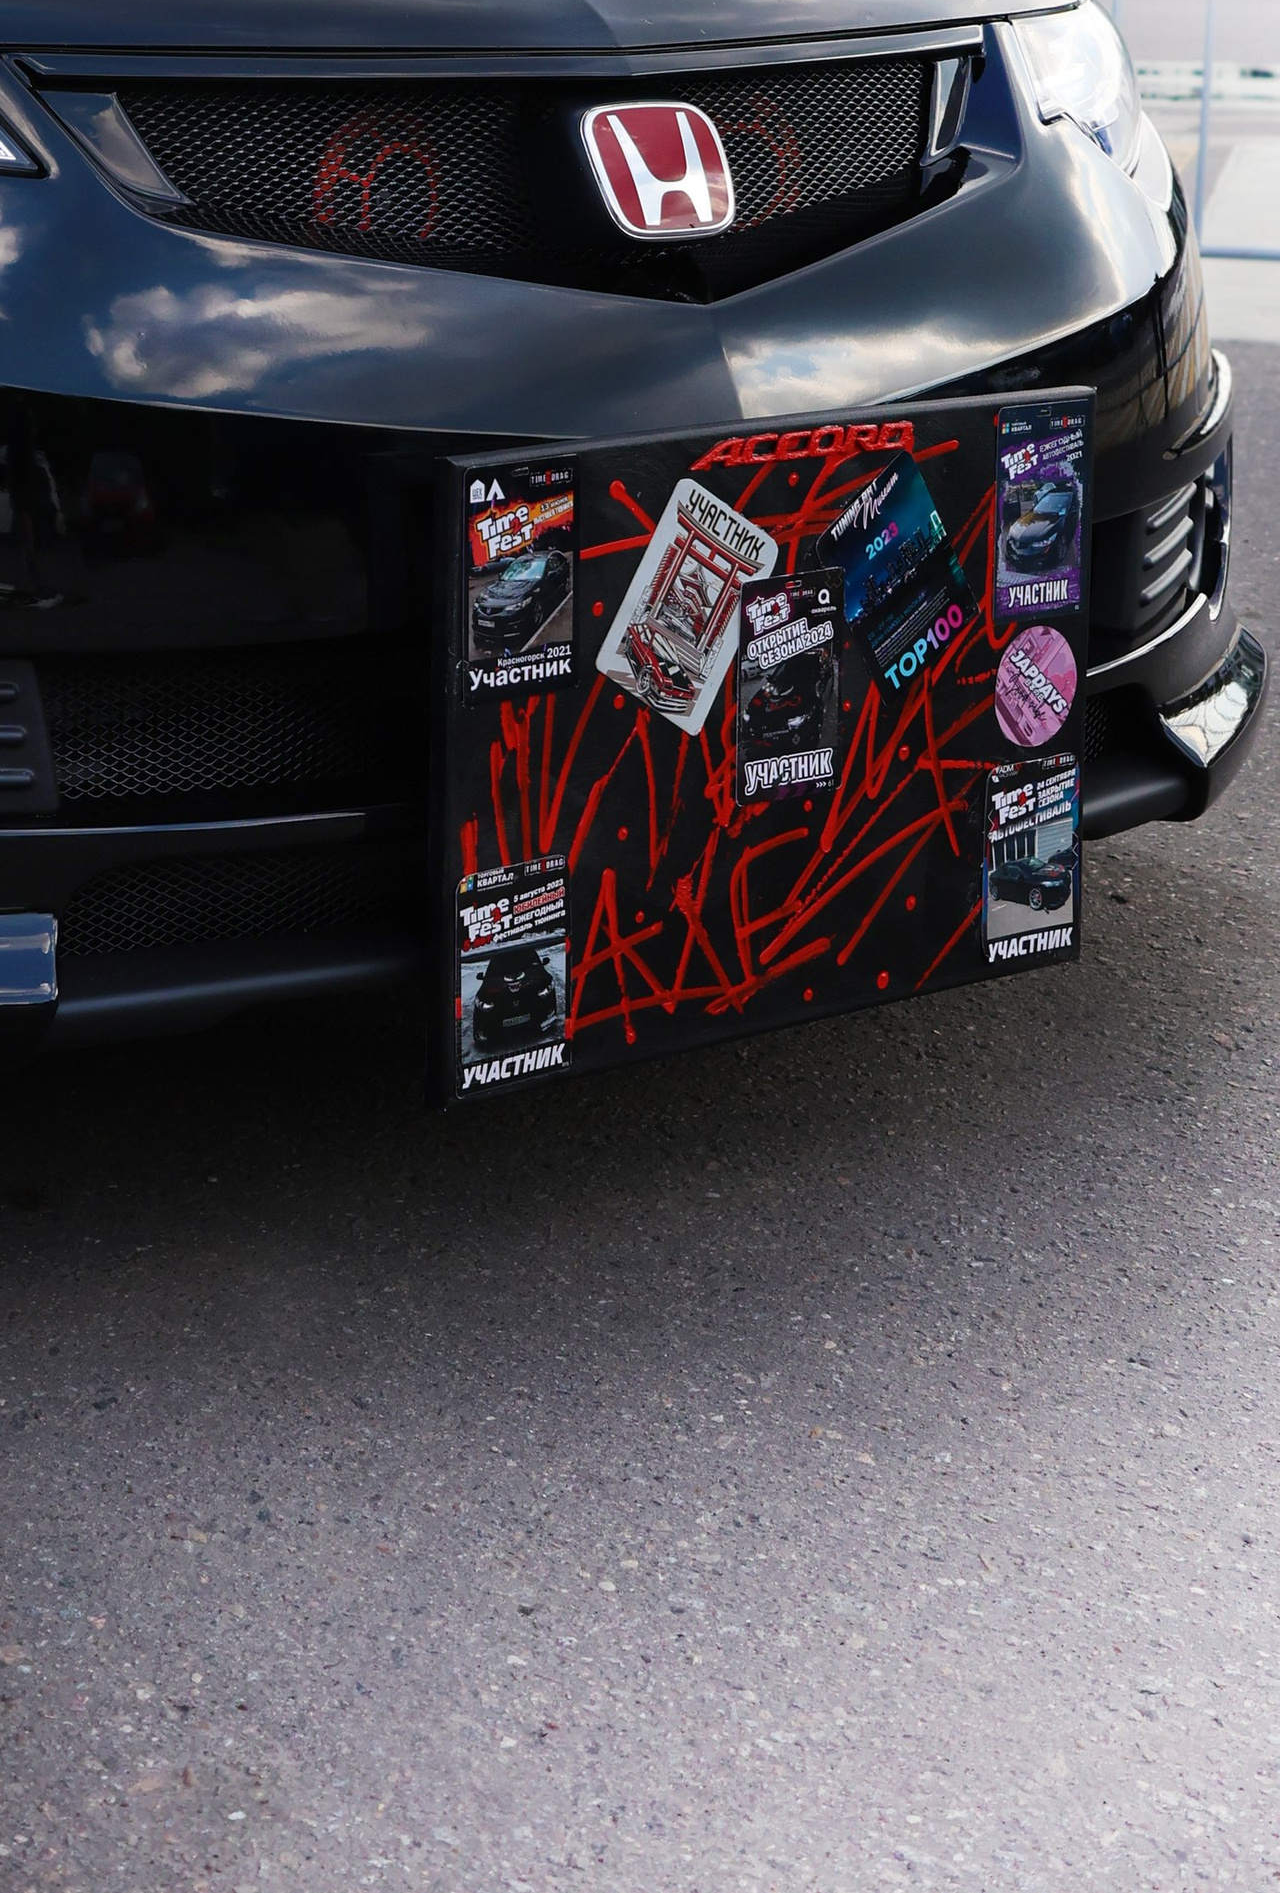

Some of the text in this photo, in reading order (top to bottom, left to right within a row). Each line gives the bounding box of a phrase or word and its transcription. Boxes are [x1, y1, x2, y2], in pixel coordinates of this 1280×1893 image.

[688, 421, 914, 471] ACCORD
[1039, 428, 1083, 453] ЕЖЕГОДНЫЙ
[1065, 450, 1083, 462] 2021
[685, 488, 766, 561] УЧАСТНИК
[865, 521, 899, 561] 2023
[1008, 579, 1069, 608] УЧАСТНИК
[497, 644, 572, 667] Красногорск 2021
[749, 620, 808, 658] ОТКРЫТИЕ
[761, 622, 833, 667] СЕЗОНА 2024
[883, 604, 963, 690] TOP100
[468, 658, 572, 691] Участник
[1009, 649, 1068, 713] JAPDAYS
[746, 750, 831, 793] УЧАСТНИК
[1045, 768, 1076, 788] СЕНТЯБРЯ
[1037, 778, 1075, 800] ЗАКРЫТИЕ
[1038, 791, 1064, 809] СЕЗОНА
[477, 872, 514, 888] КВАРТАЛ
[519, 886, 546, 901] августа
[546, 878, 564, 891] 2023
[513, 887, 566, 915] ЮБИЛЕЙНЫЙ
[513, 898, 564, 926] ЕЖЕГОДНЫЙ
[493, 922, 534, 943] фестиваль
[534, 910, 566, 927] тюнинга
[988, 926, 1074, 963] УЧАСТНИК
[462, 1043, 566, 1090] УЧАСТНИК
